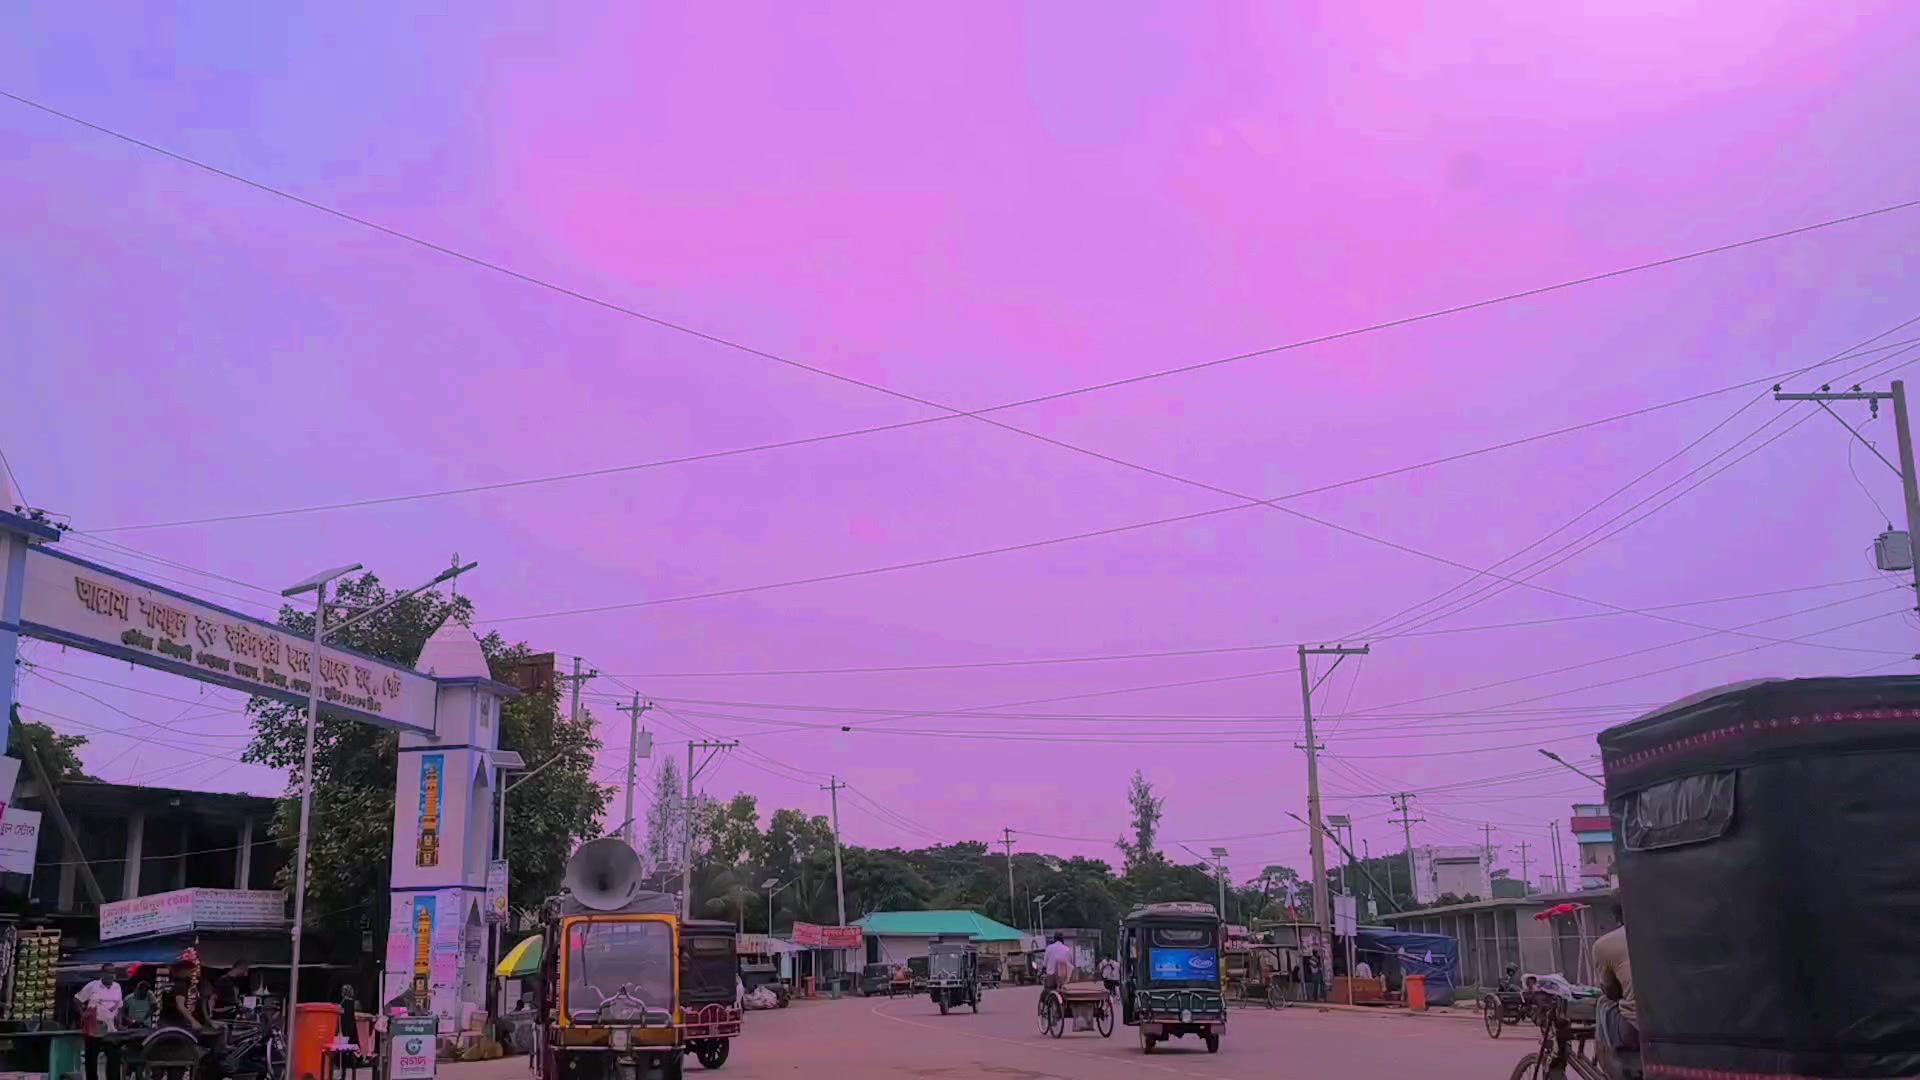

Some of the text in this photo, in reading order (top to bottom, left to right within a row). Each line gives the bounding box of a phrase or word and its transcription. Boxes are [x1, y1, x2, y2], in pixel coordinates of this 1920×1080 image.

[75, 576, 129, 621] আল্লামা
[138, 596, 188, 638] শামছুল
[195, 615, 219, 647] হক
[400, 1056, 426, 1067] নগদ
